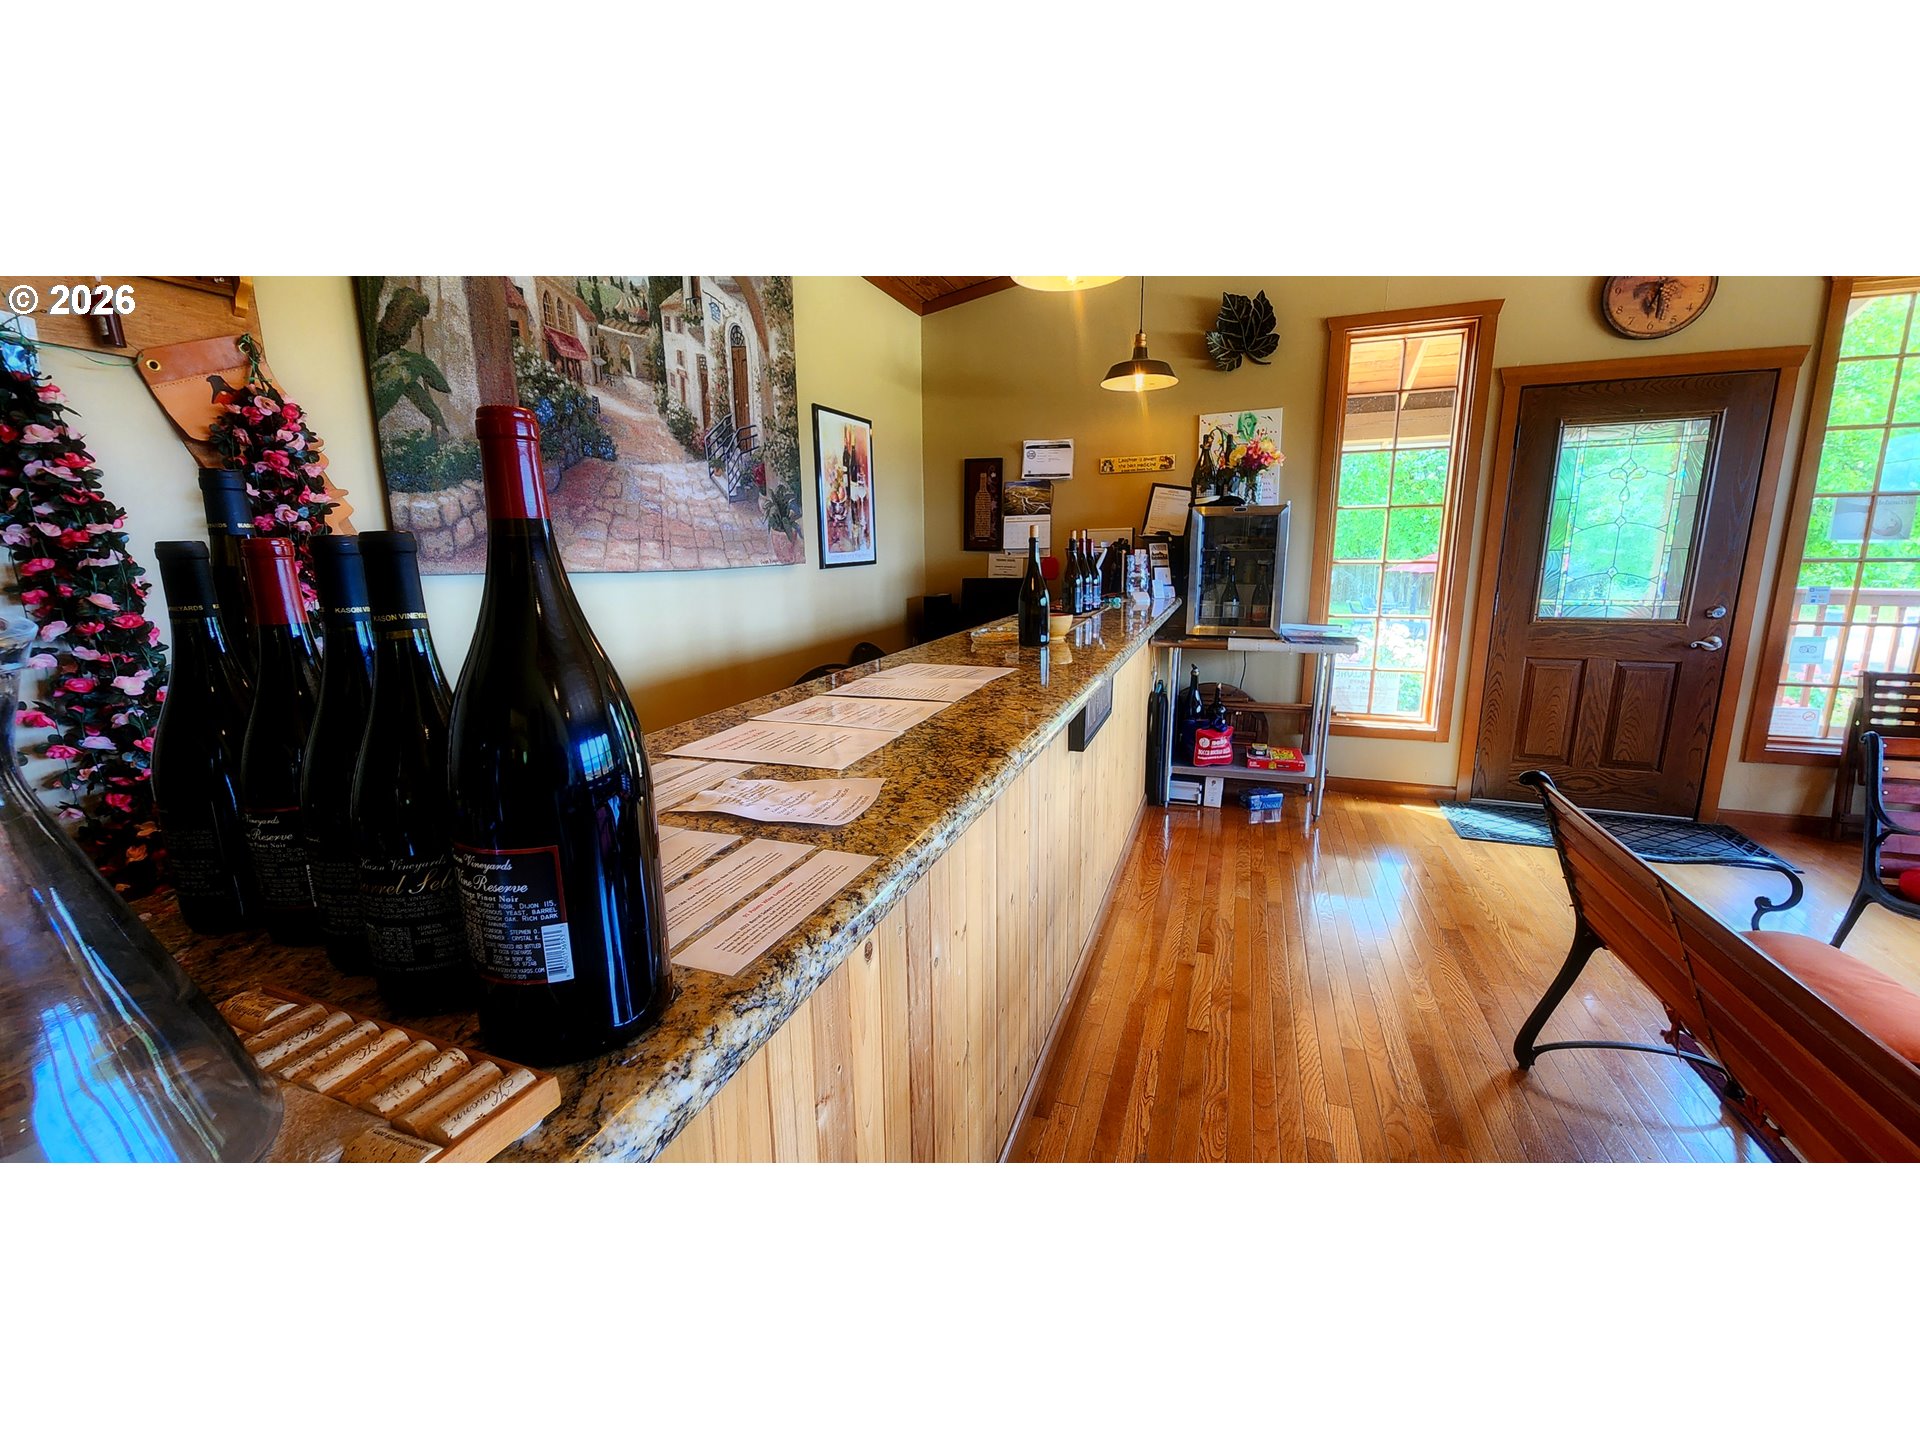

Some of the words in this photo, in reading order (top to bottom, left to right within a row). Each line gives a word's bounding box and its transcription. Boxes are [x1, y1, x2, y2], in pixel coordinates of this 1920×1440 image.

[1615, 287, 1622, 296] 9
[1698, 284, 1705, 293] 3
[1616, 306, 1623, 314] 8
[1686, 303, 1693, 312] 4
[1628, 317, 1635, 325] 7
[1670, 315, 1677, 324] 5
[1646, 321, 1654, 330] 6
[250, 828, 293, 841] Reserve
[463, 853, 513, 874] Vineyards
[472, 874, 528, 893] Reserve
[498, 895, 519, 903] Noir
[519, 902, 539, 910] DIJON
[531, 907, 558, 915] BARREL
[540, 913, 559, 921] DARK
